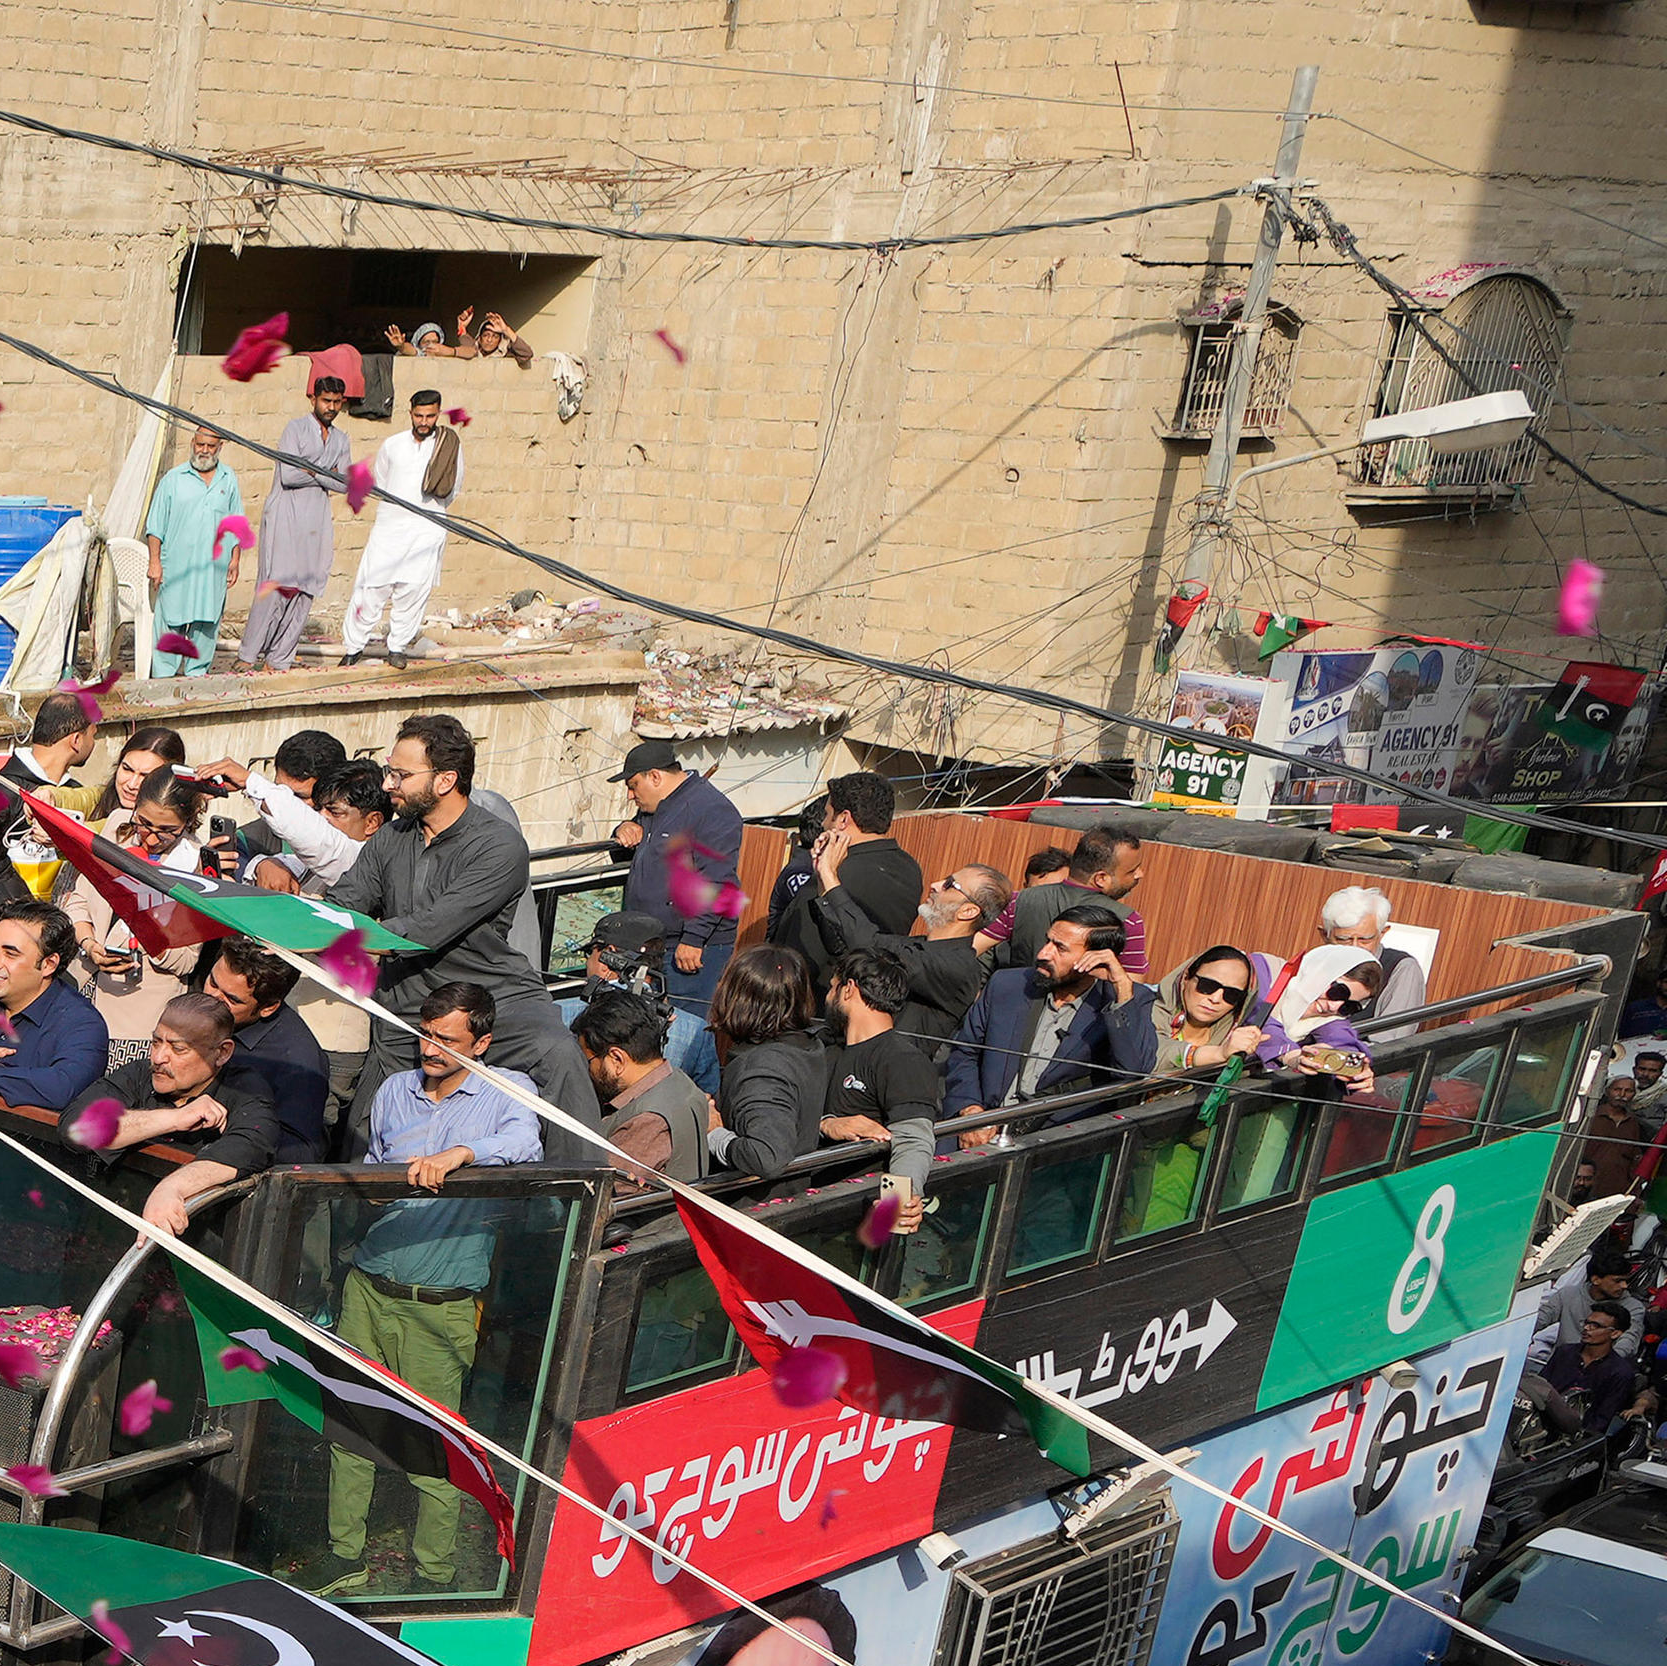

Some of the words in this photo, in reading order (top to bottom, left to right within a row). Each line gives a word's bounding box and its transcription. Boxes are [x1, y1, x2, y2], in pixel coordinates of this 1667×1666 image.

[1162, 749, 1246, 779] AGENCY
[1381, 724, 1441, 752] AGENCY
[1442, 722, 1460, 747] 91
[1186, 774, 1210, 796] 91
[1511, 769, 1563, 787] SHOP
[1387, 1183, 1457, 1335] 8
[1352, 1355, 1505, 1517] چنو
[591, 1465, 676, 1580] کو
[650, 1427, 789, 1586] سوچ
